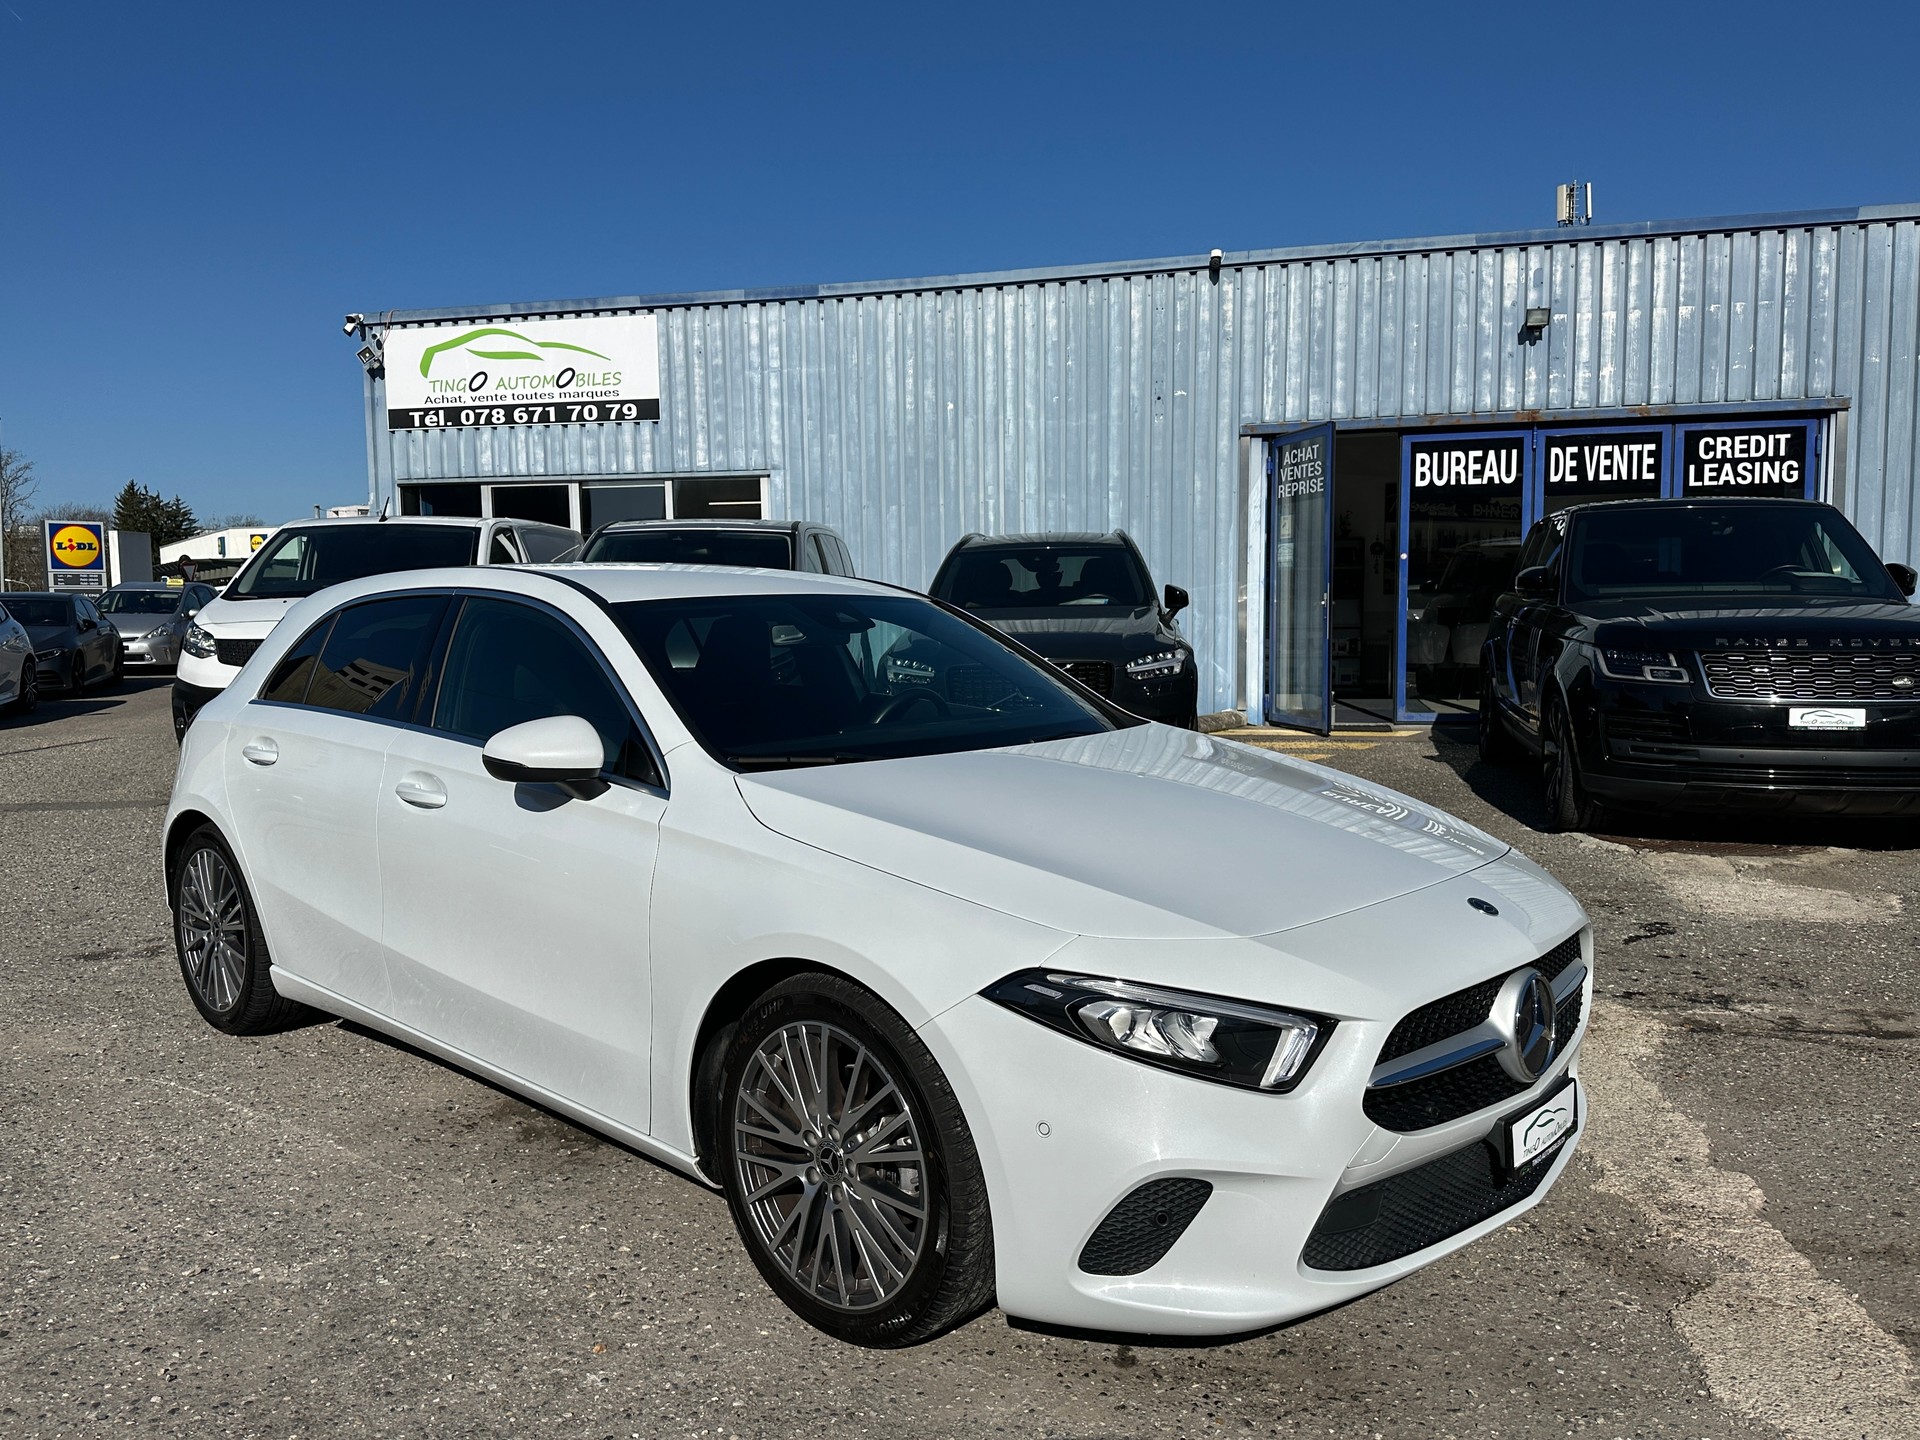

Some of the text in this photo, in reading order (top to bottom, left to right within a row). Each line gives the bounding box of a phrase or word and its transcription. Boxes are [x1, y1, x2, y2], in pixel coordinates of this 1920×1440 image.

[429, 367, 622, 393] TINGO AUTOMOBILES
[424, 389, 620, 405] Achat, vente toutes marques
[409, 403, 638, 427] Tél. 078 671 70 79
[1283, 444, 1319, 465] ACHAT
[1699, 434, 1791, 459] CREDIT
[1280, 461, 1322, 482] VENTES
[1415, 443, 1656, 487] BUREAU DE VENTE
[1689, 460, 1799, 486] LEASING
[1278, 477, 1324, 498] REPRISE
[1715, 638, 1809, 647] RANGE
[760, 998, 785, 1019] UHP
